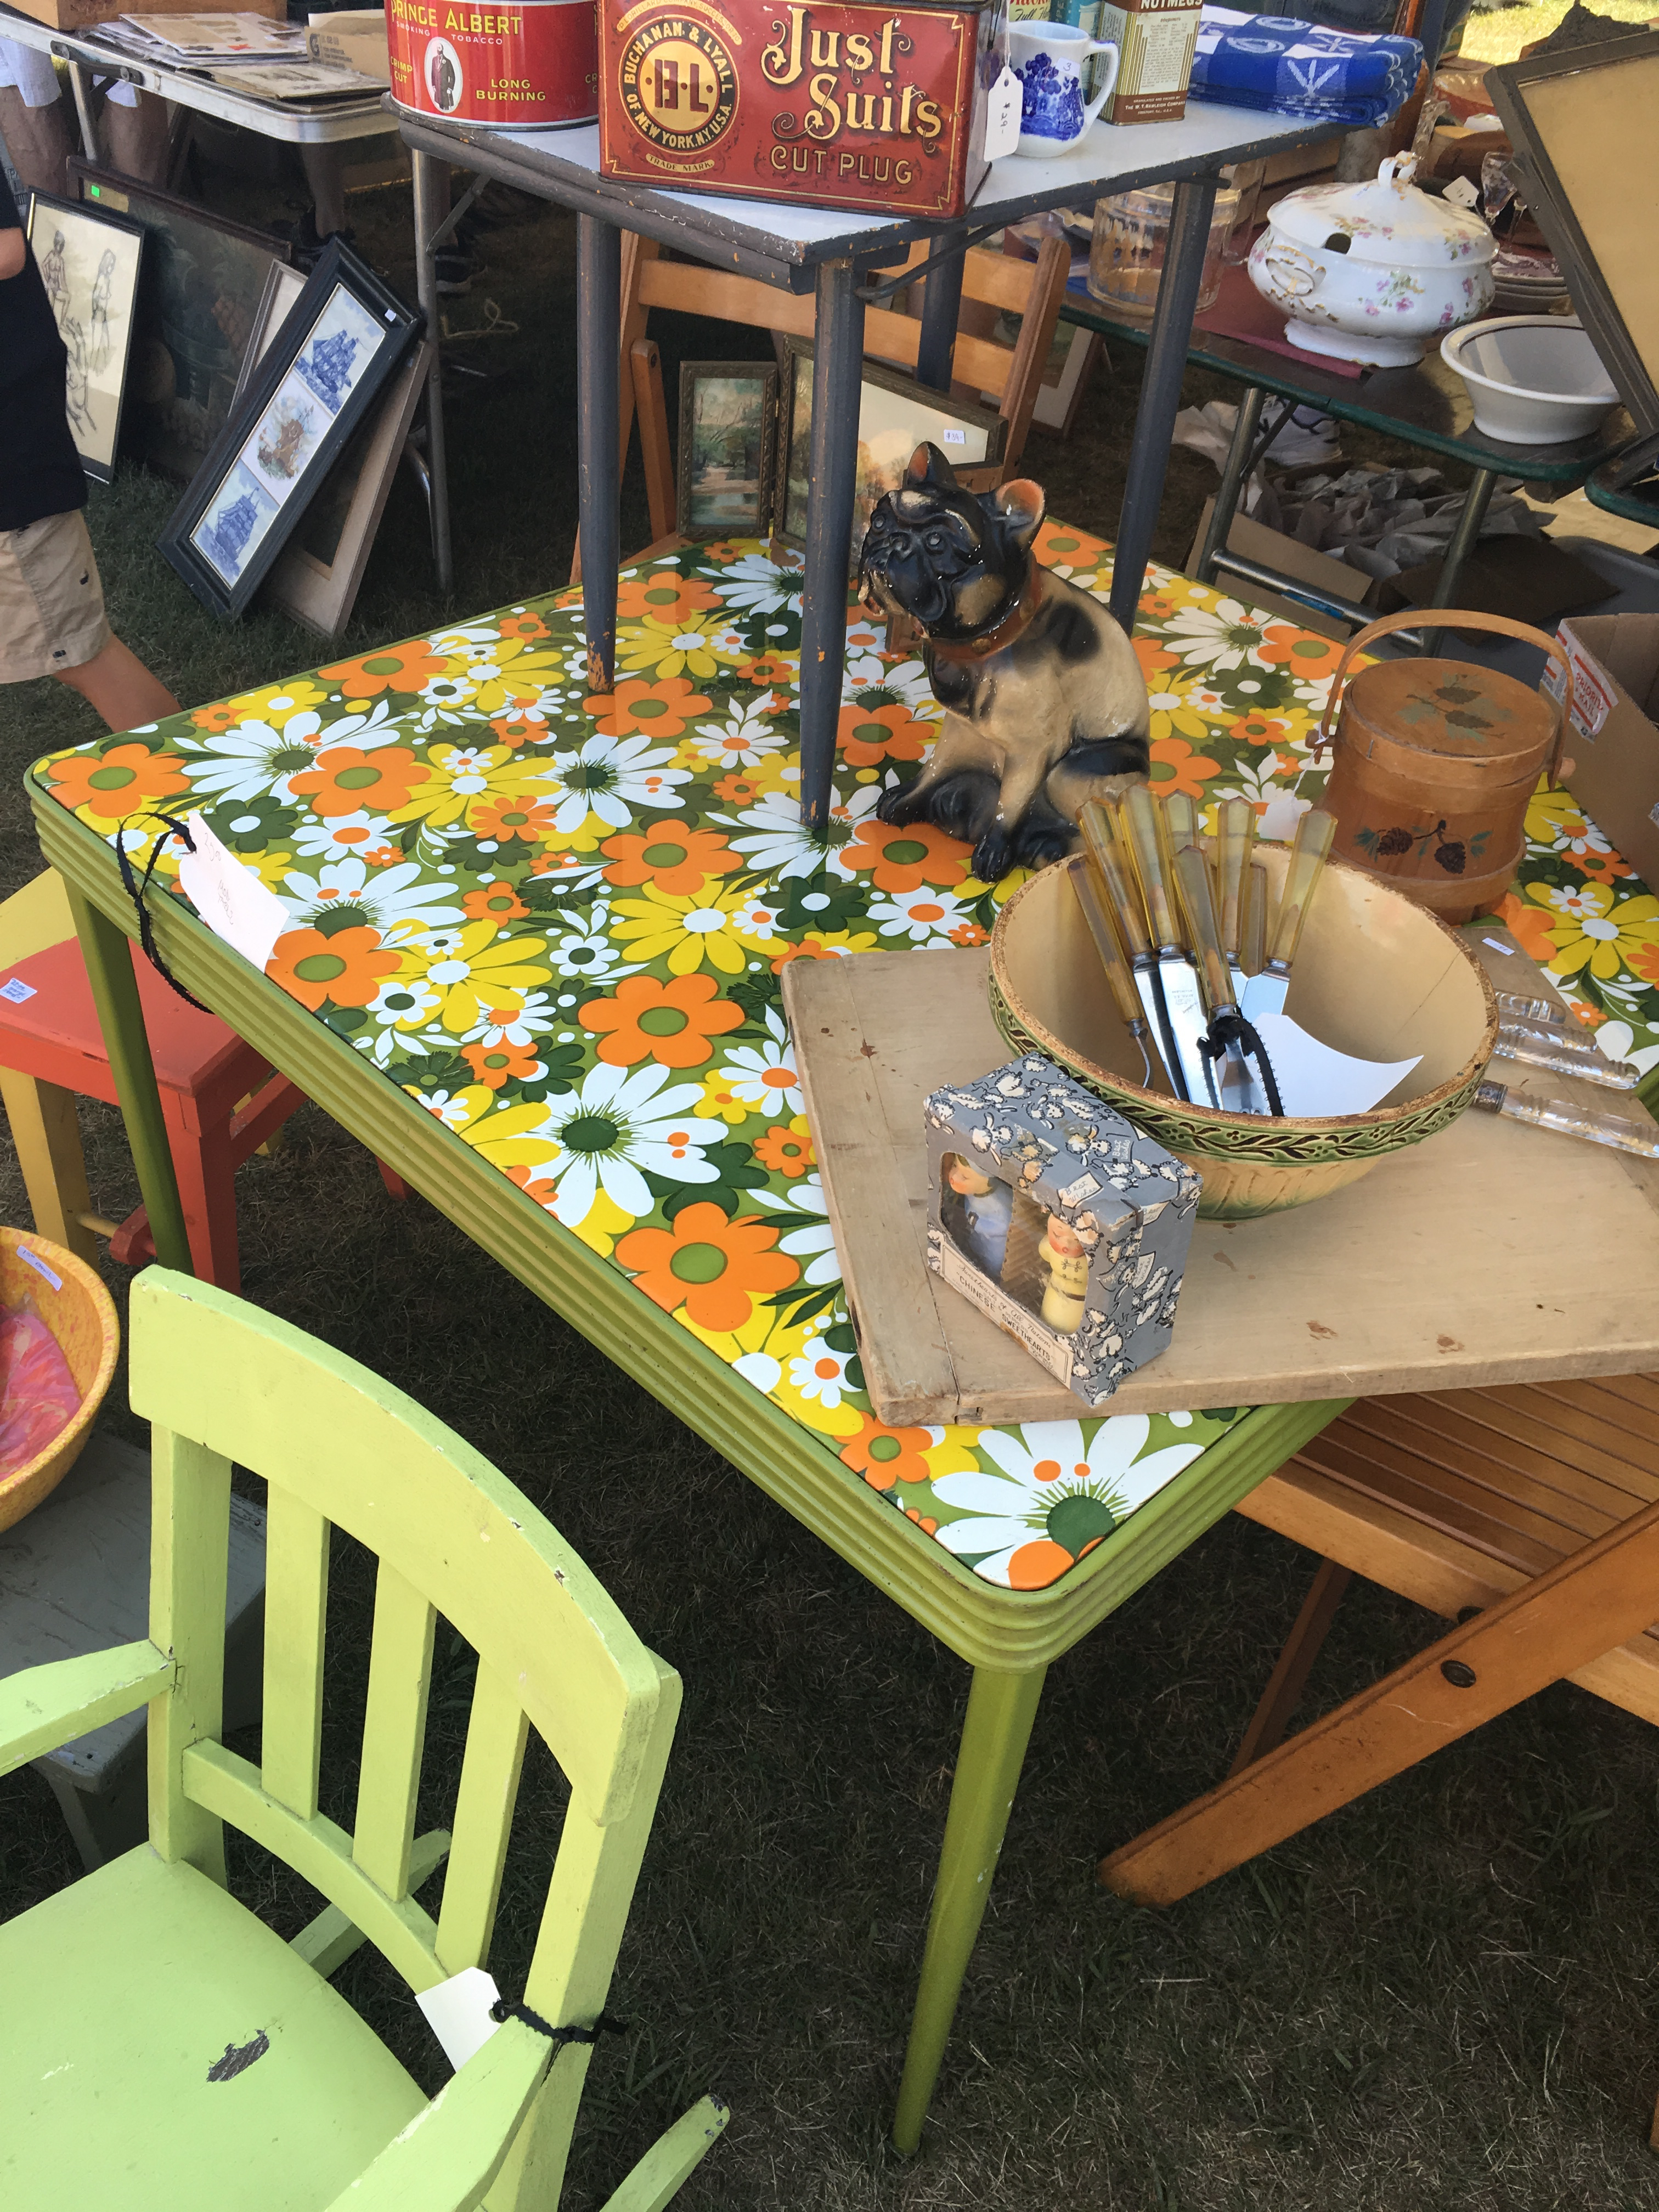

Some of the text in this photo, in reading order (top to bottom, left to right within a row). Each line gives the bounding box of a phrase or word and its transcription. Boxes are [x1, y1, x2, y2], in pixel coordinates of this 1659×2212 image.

[391, 0, 522, 35] PRINCE ALBERT
[396, 20, 503, 45] SMOKING TOBACCO
[761, 7, 911, 84] Just
[391, 55, 413, 73] CRIMP
[689, 26, 700, 43] &
[703, 37, 733, 94] LYALL
[394, 70, 407, 83] CUT
[491, 78, 531, 89] LONG
[476, 89, 546, 101] BURNING
[627, 93, 641, 110] OF
[635, 111, 662, 139] NEW
[772, 73, 941, 153] Suits
[650, 156, 678, 171] TRADE
[771, 145, 912, 184] CUT PLUG
[1064, 1180, 1088, 1196] Best
